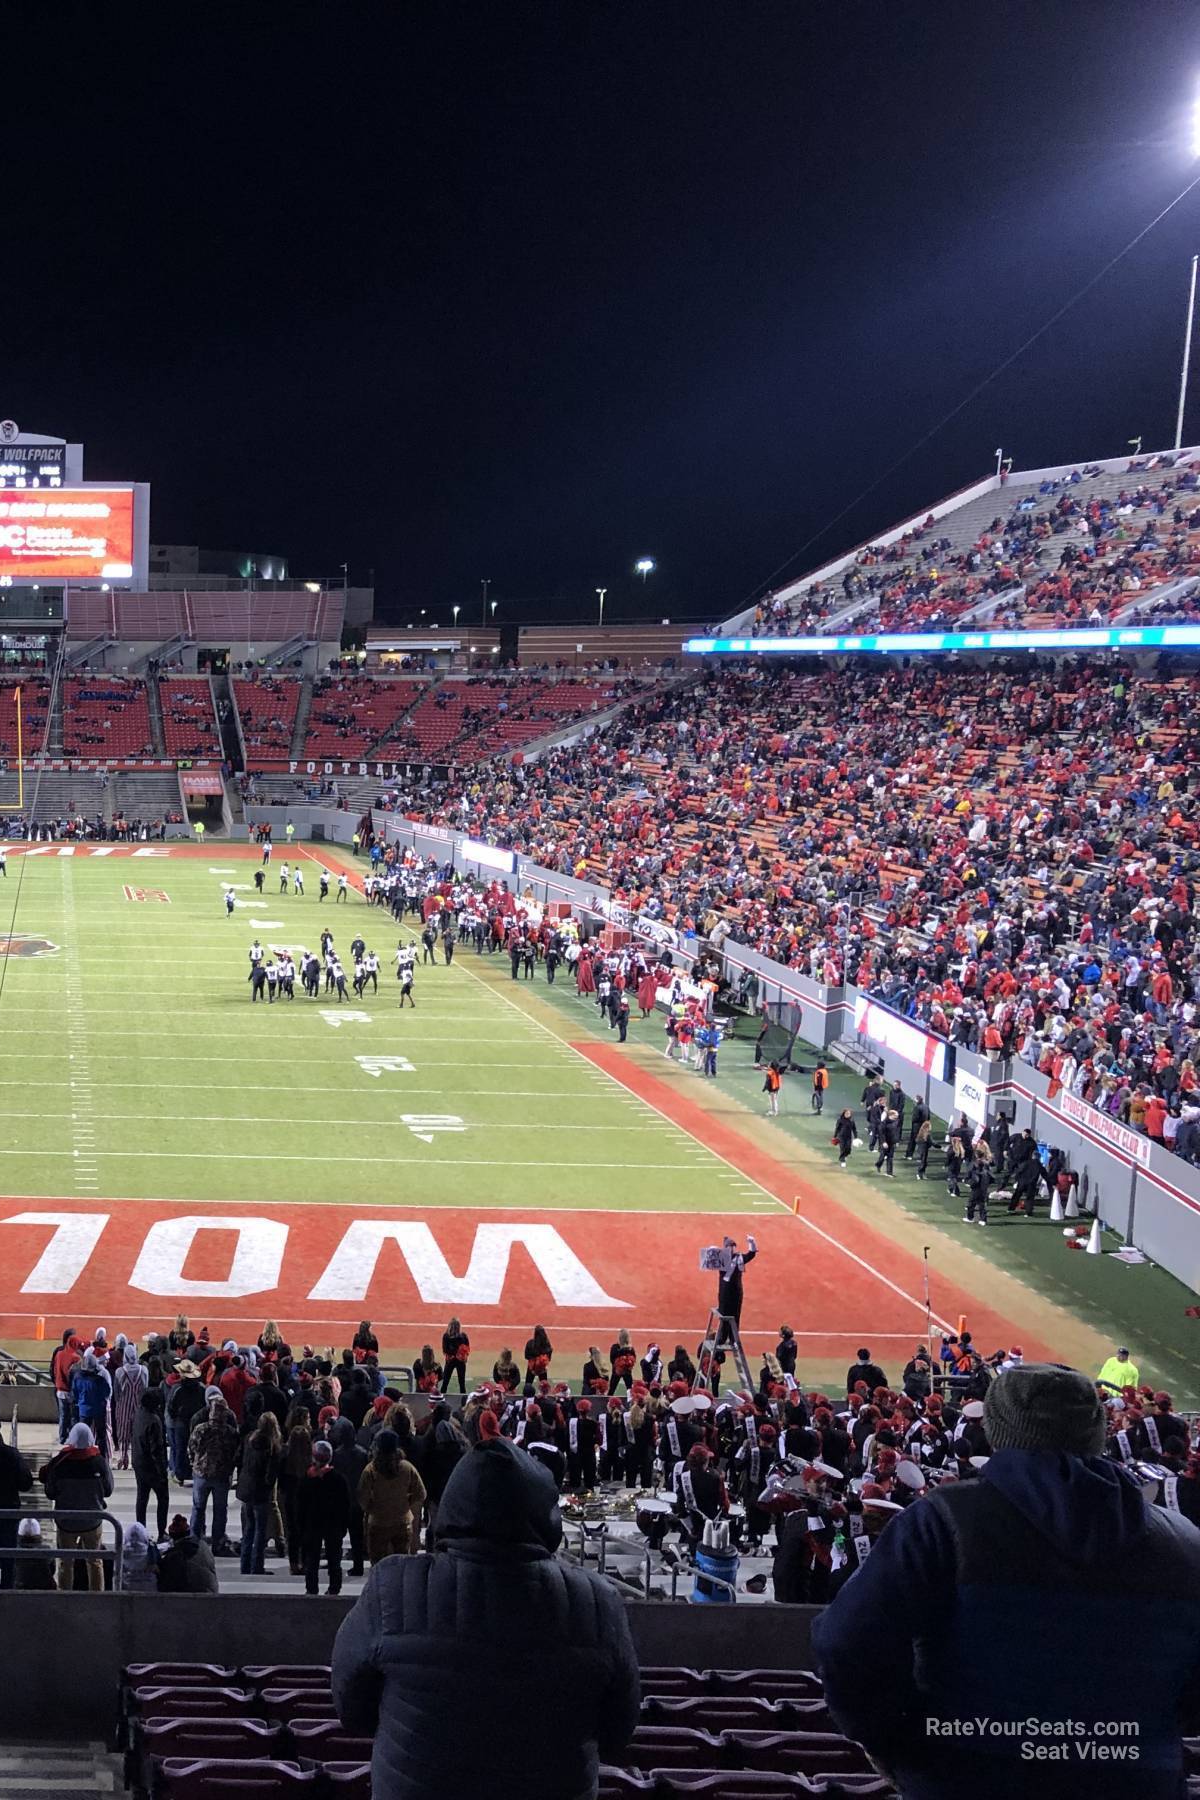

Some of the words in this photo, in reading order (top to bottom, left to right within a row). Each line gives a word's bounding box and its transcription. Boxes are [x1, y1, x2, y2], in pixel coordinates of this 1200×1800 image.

[4, 448, 62, 461] WOLFPACK
[289, 761, 413, 778] FOOTBALL
[1063, 1094, 1088, 1121] STUDENT
[1087, 1110, 1121, 1143] WOLFPACK
[1121, 1133, 1140, 1155] CLUB
